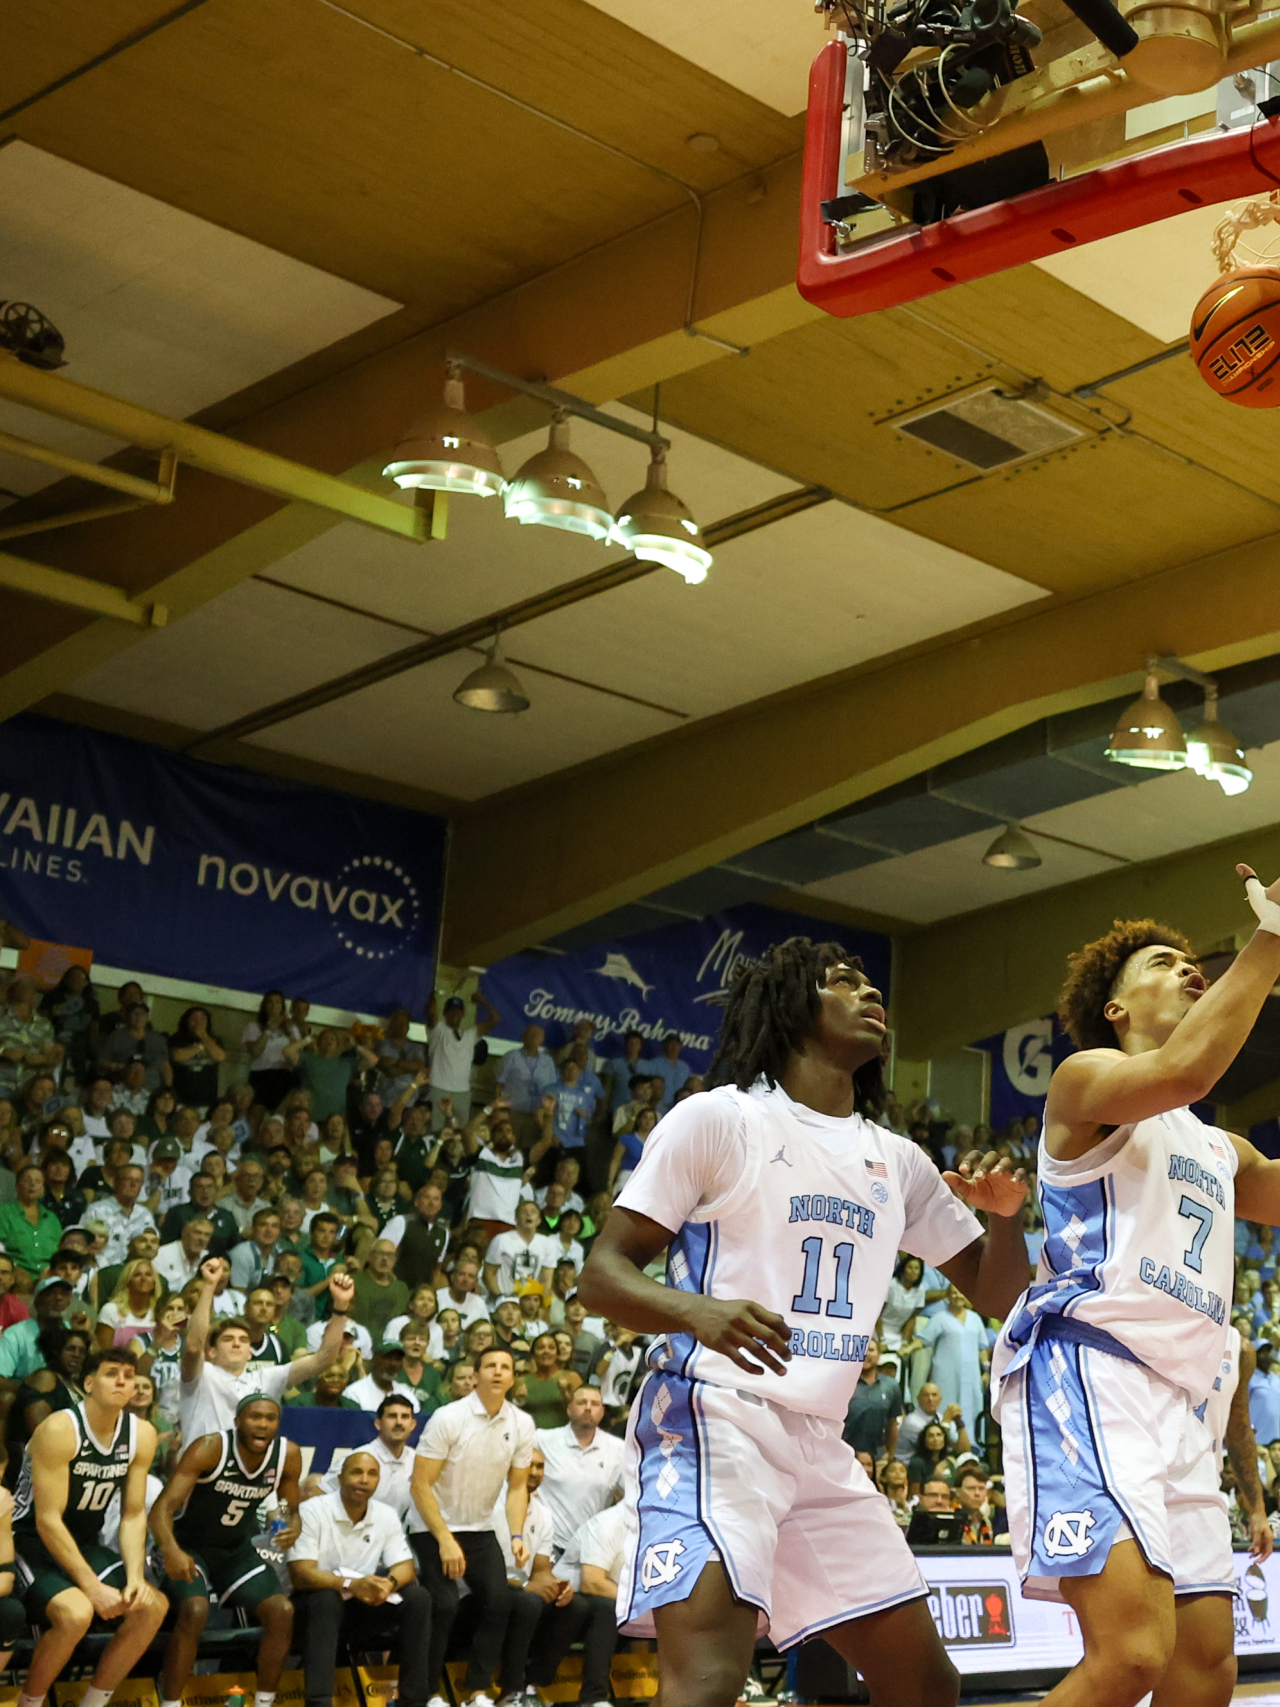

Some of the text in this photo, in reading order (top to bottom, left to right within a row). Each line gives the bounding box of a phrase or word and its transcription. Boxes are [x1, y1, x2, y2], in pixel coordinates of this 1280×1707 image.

[1209, 323, 1271, 380] ELITE
[197, 854, 404, 928] novavax
[789, 1194, 876, 1238] NORTH
[1178, 1194, 1213, 1274] 7
[791, 1236, 855, 1319] 11
[73, 1461, 129, 1479] SPARTANS
[77, 1480, 115, 1511] 10
[221, 1499, 250, 1526] 5
[926, 1586, 983, 1640] eber
